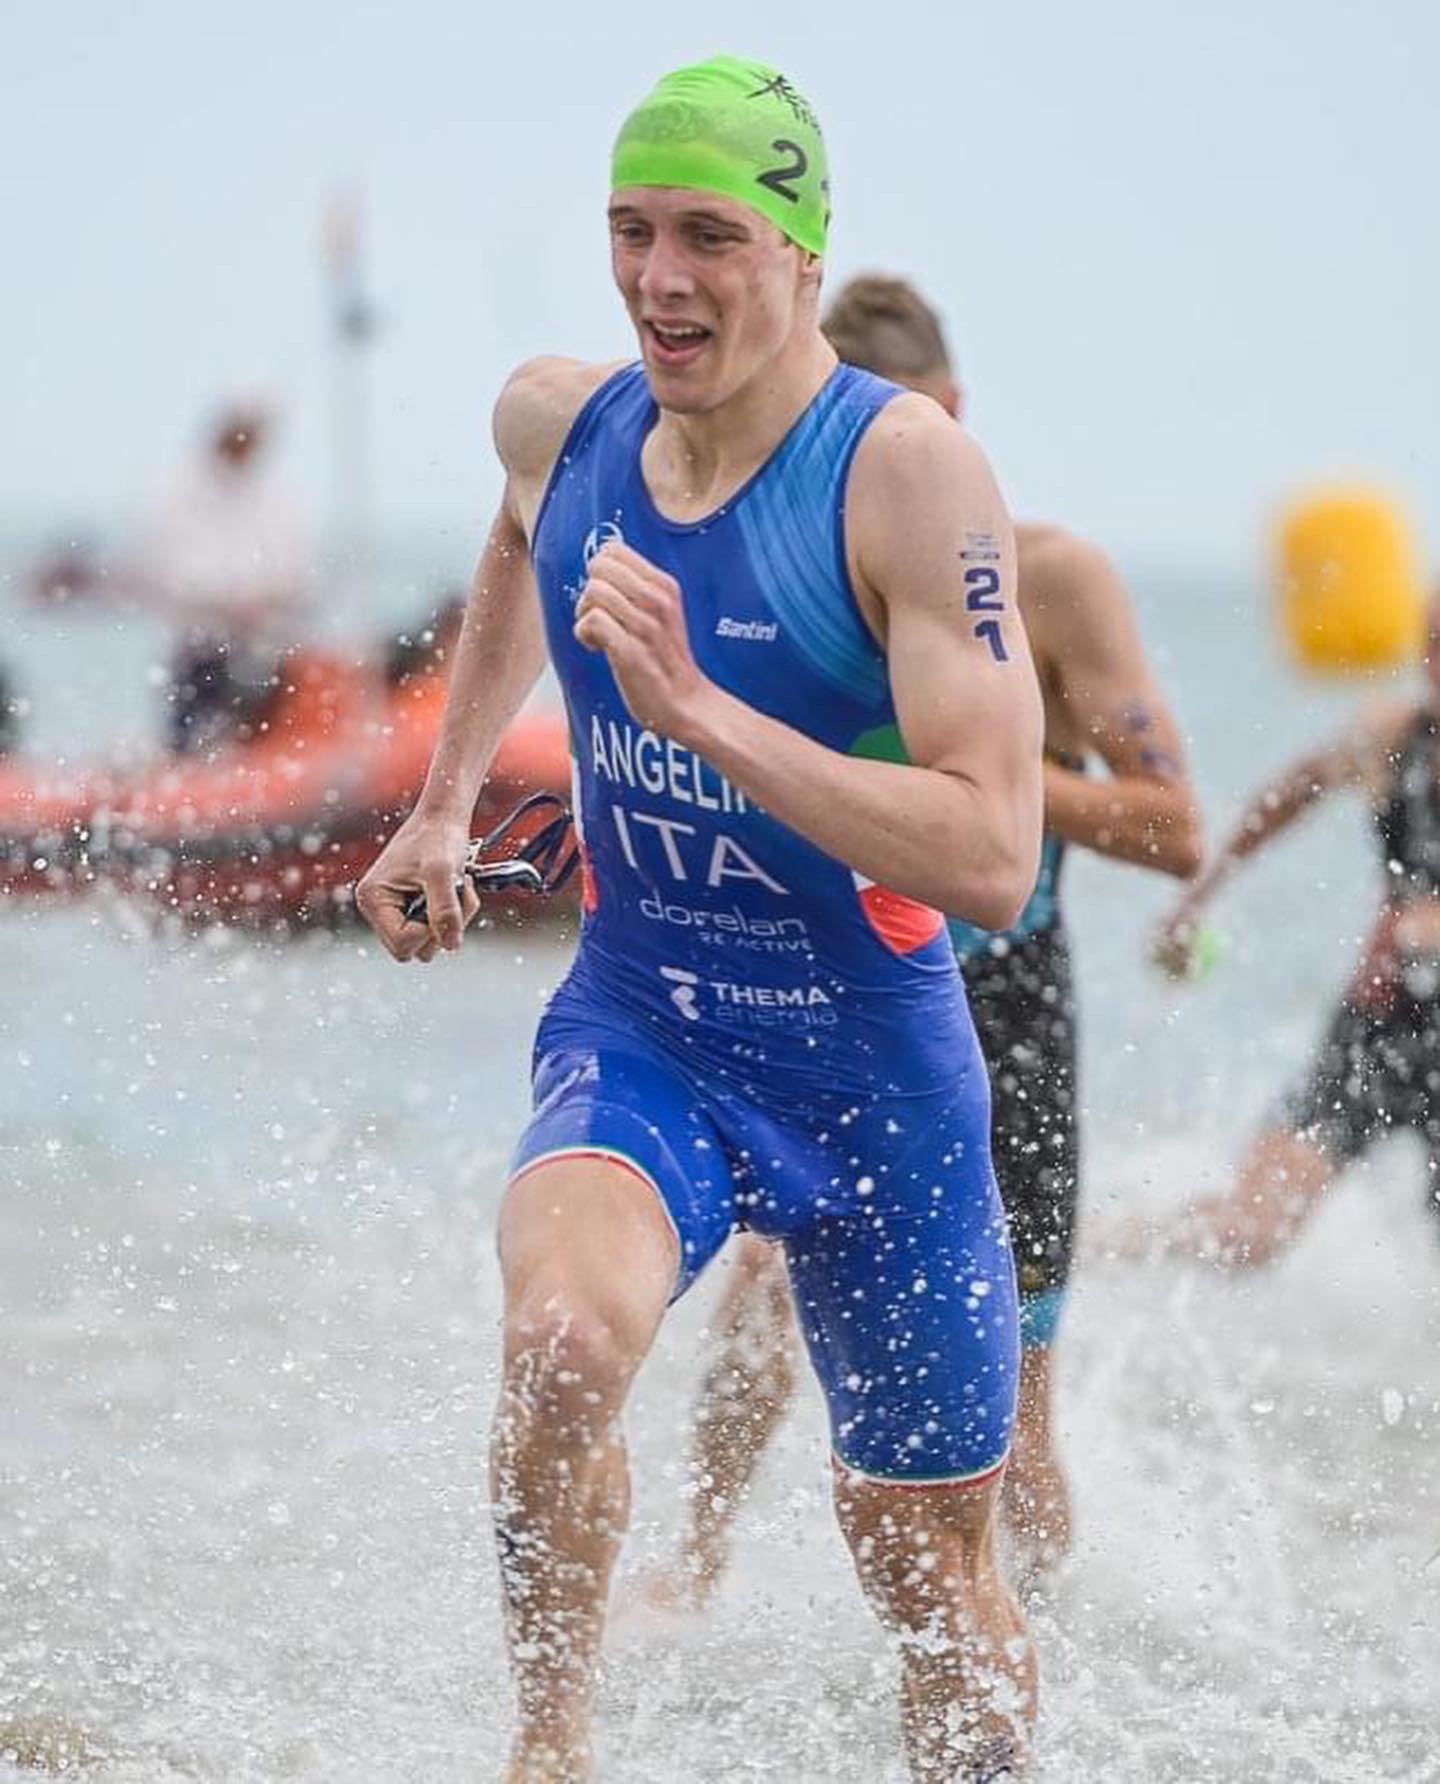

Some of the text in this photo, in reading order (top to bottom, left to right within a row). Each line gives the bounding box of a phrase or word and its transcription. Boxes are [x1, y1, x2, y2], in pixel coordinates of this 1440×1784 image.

[715, 617, 778, 641] Santini
[592, 715, 766, 814] ANGELI
[612, 804, 790, 895] ITA
[640, 884, 807, 936] dorelan
[709, 981, 830, 1006] THEMA
